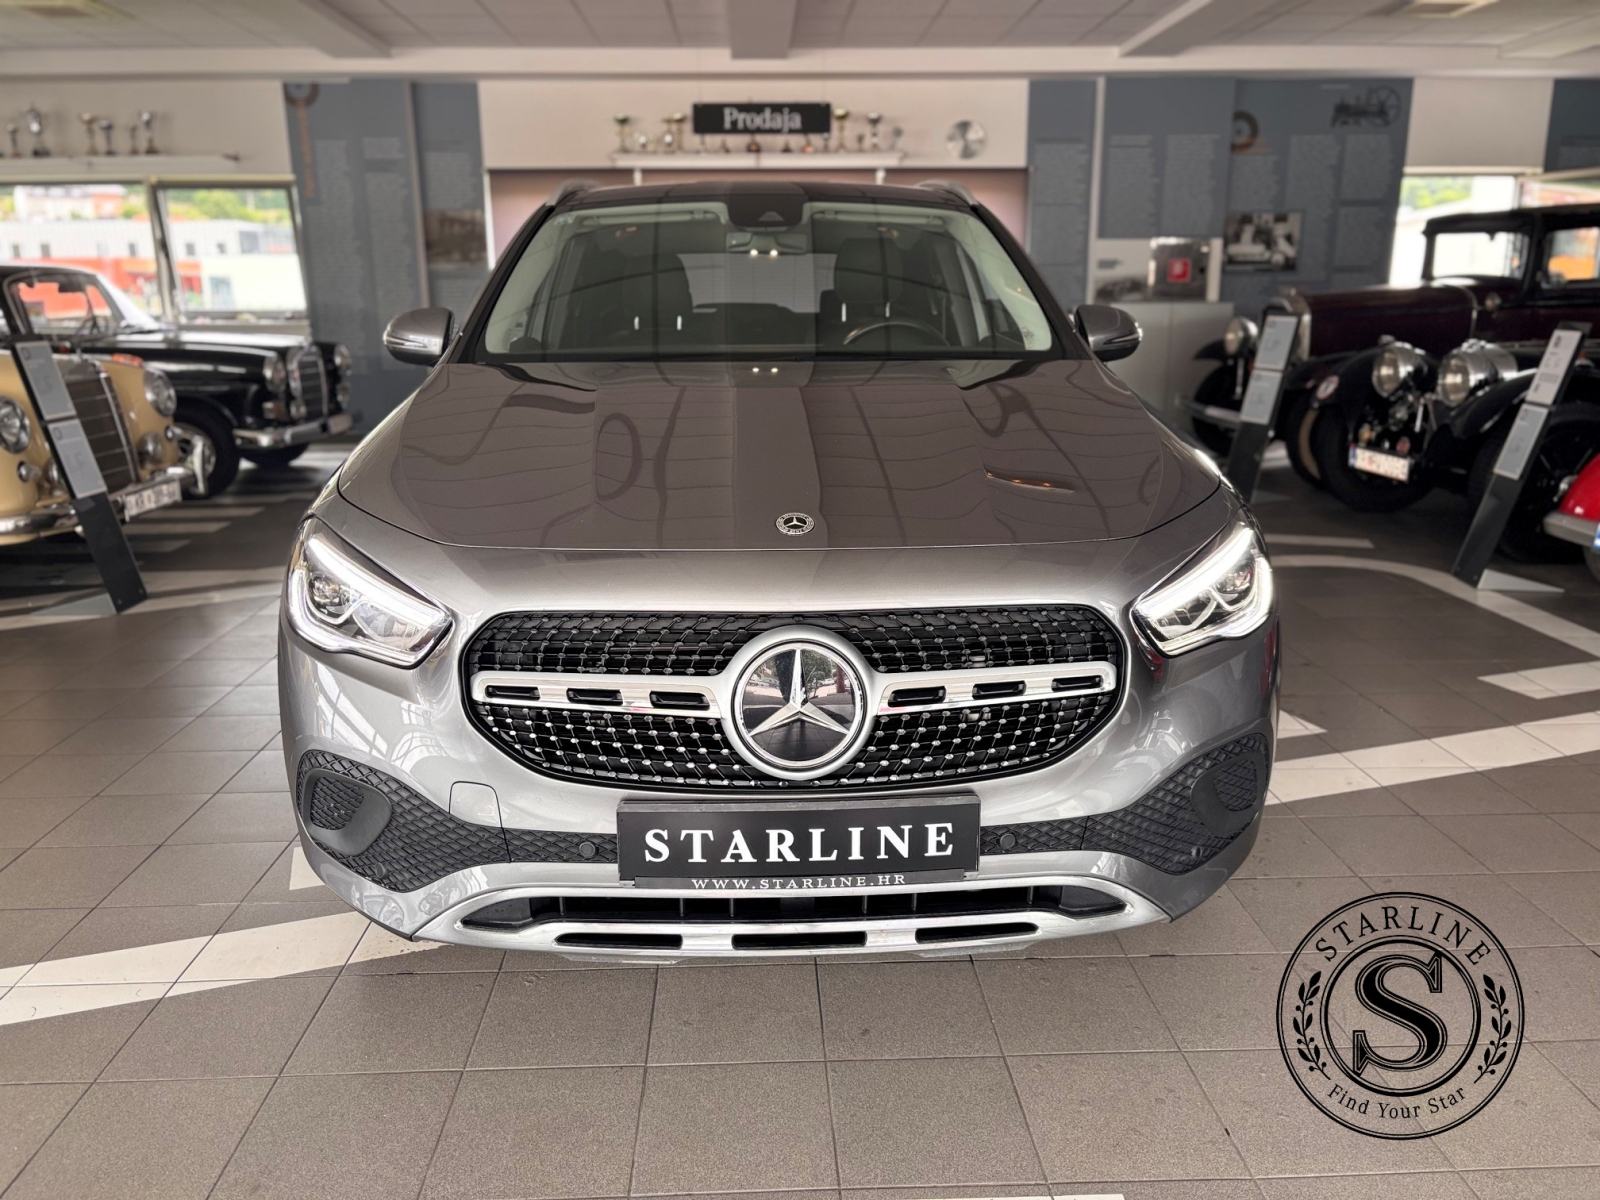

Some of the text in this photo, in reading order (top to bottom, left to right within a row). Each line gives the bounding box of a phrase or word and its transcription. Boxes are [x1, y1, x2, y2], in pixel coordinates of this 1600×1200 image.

[723, 106, 802, 133] Prodaja
[644, 822, 954, 863] STARLINE
[691, 874, 906, 890] WWW.STARLINE.HR
